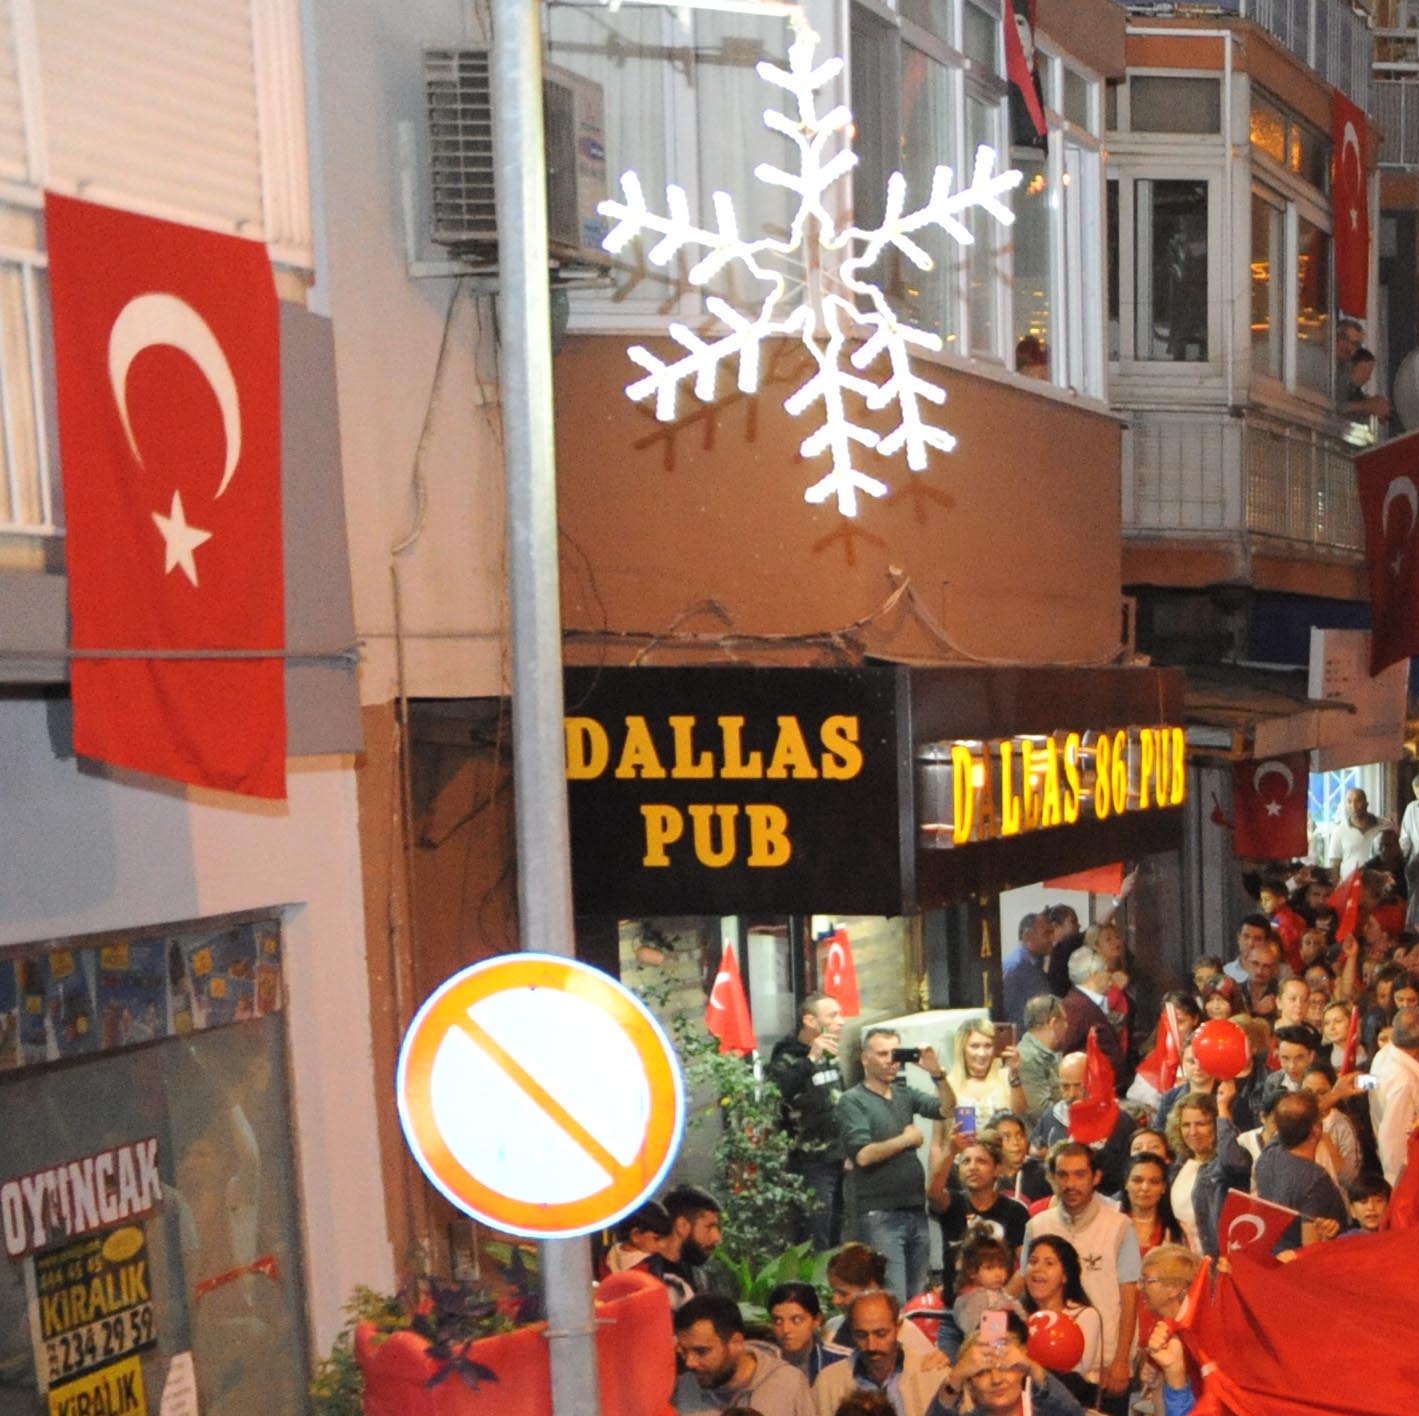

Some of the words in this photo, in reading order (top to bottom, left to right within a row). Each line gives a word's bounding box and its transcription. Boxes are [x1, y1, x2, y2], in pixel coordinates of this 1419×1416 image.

[564, 715, 863, 780] DALLAS
[951, 732, 1081, 844] DALLAS
[1095, 730, 1127, 819] 86
[1139, 727, 1187, 808] PUB
[640, 804, 792, 868] PUB
